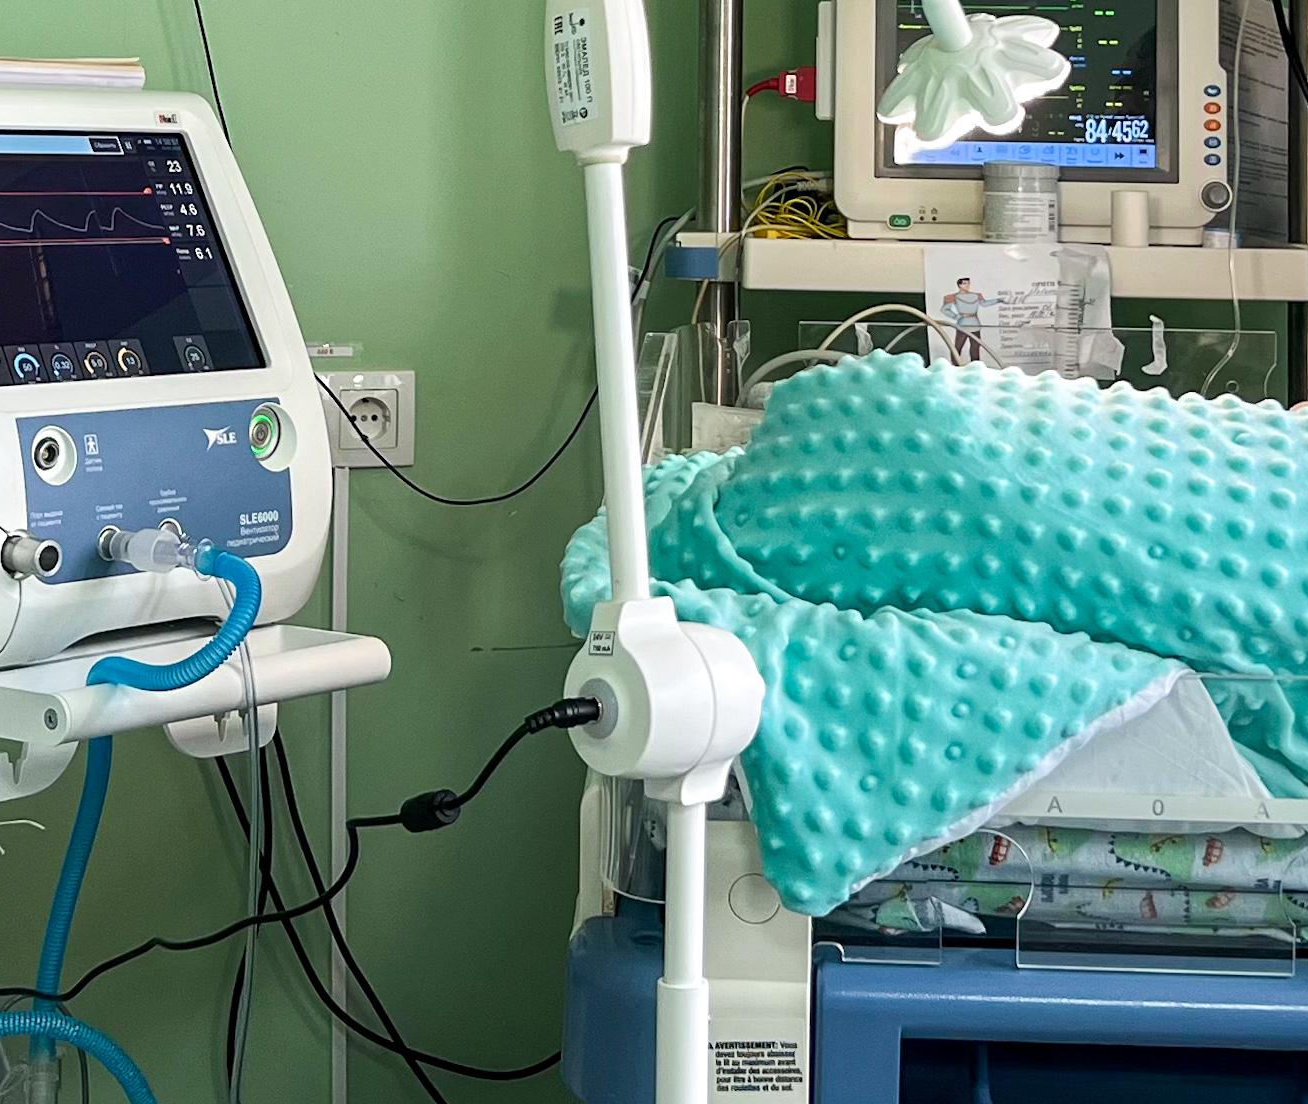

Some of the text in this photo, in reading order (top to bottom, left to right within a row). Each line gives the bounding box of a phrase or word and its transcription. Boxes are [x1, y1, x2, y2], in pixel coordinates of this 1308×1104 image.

[166, 160, 183, 173] 23
[169, 182, 194, 196] 11.9
[179, 203, 198, 217] 4.6
[185, 224, 206, 237] 7.6
[194, 247, 213, 260] 6.1
[216, 431, 237, 445] SLE
[239, 510, 279, 526] SLE6000
[714, 1040, 778, 1049] AVERTISSEMENT:
